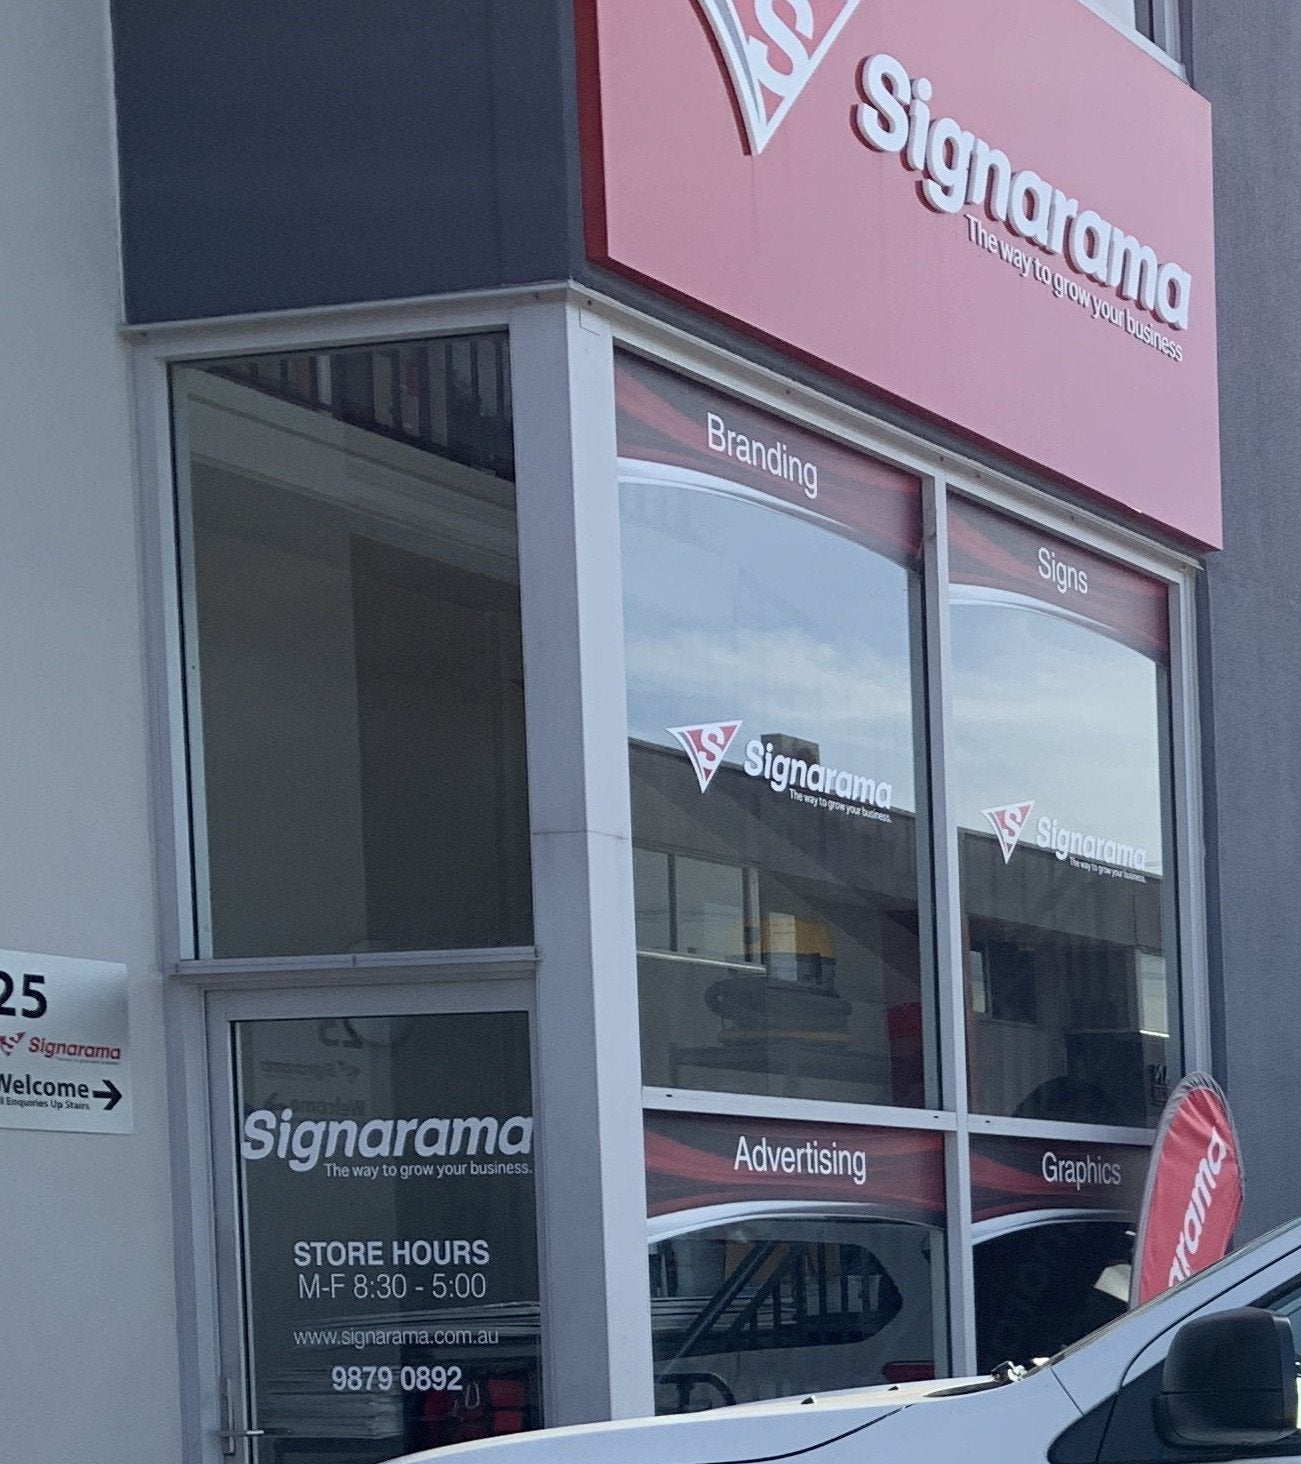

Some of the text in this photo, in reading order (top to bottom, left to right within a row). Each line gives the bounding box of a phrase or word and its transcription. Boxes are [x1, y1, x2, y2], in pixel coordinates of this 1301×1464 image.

[855, 54, 1191, 330] Signarama
[964, 213, 1184, 362] The way to grow your business
[706, 412, 819, 499] Branding
[1038, 546, 1089, 594] Signs
[743, 740, 893, 809] Signarama
[789, 788, 804, 801] The
[804, 794, 819, 807] way
[819, 797, 827, 807] to
[828, 799, 845, 811] grow
[846, 804, 861, 815] your
[1036, 816, 1147, 869] Signarama
[0, 970, 47, 1019] 25
[27, 1036, 121, 1060] Signarama
[50, 1100, 63, 1111] Up
[65, 1100, 90, 1111] Stairs
[240, 1107, 534, 1172] Signarama
[733, 1135, 866, 1185] Advertising
[324, 1160, 533, 1180] The way to grow your business.
[1041, 1151, 1122, 1191] Graphics
[294, 1239, 490, 1267] STORE HOURS
[299, 1273, 345, 1299] M-F
[353, 1273, 407, 1299] 8:30
[432, 1272, 487, 1298] 5:00
[293, 1328, 500, 1349] www.signarama.com.au
[331, 1365, 463, 1391] 9879 0892
